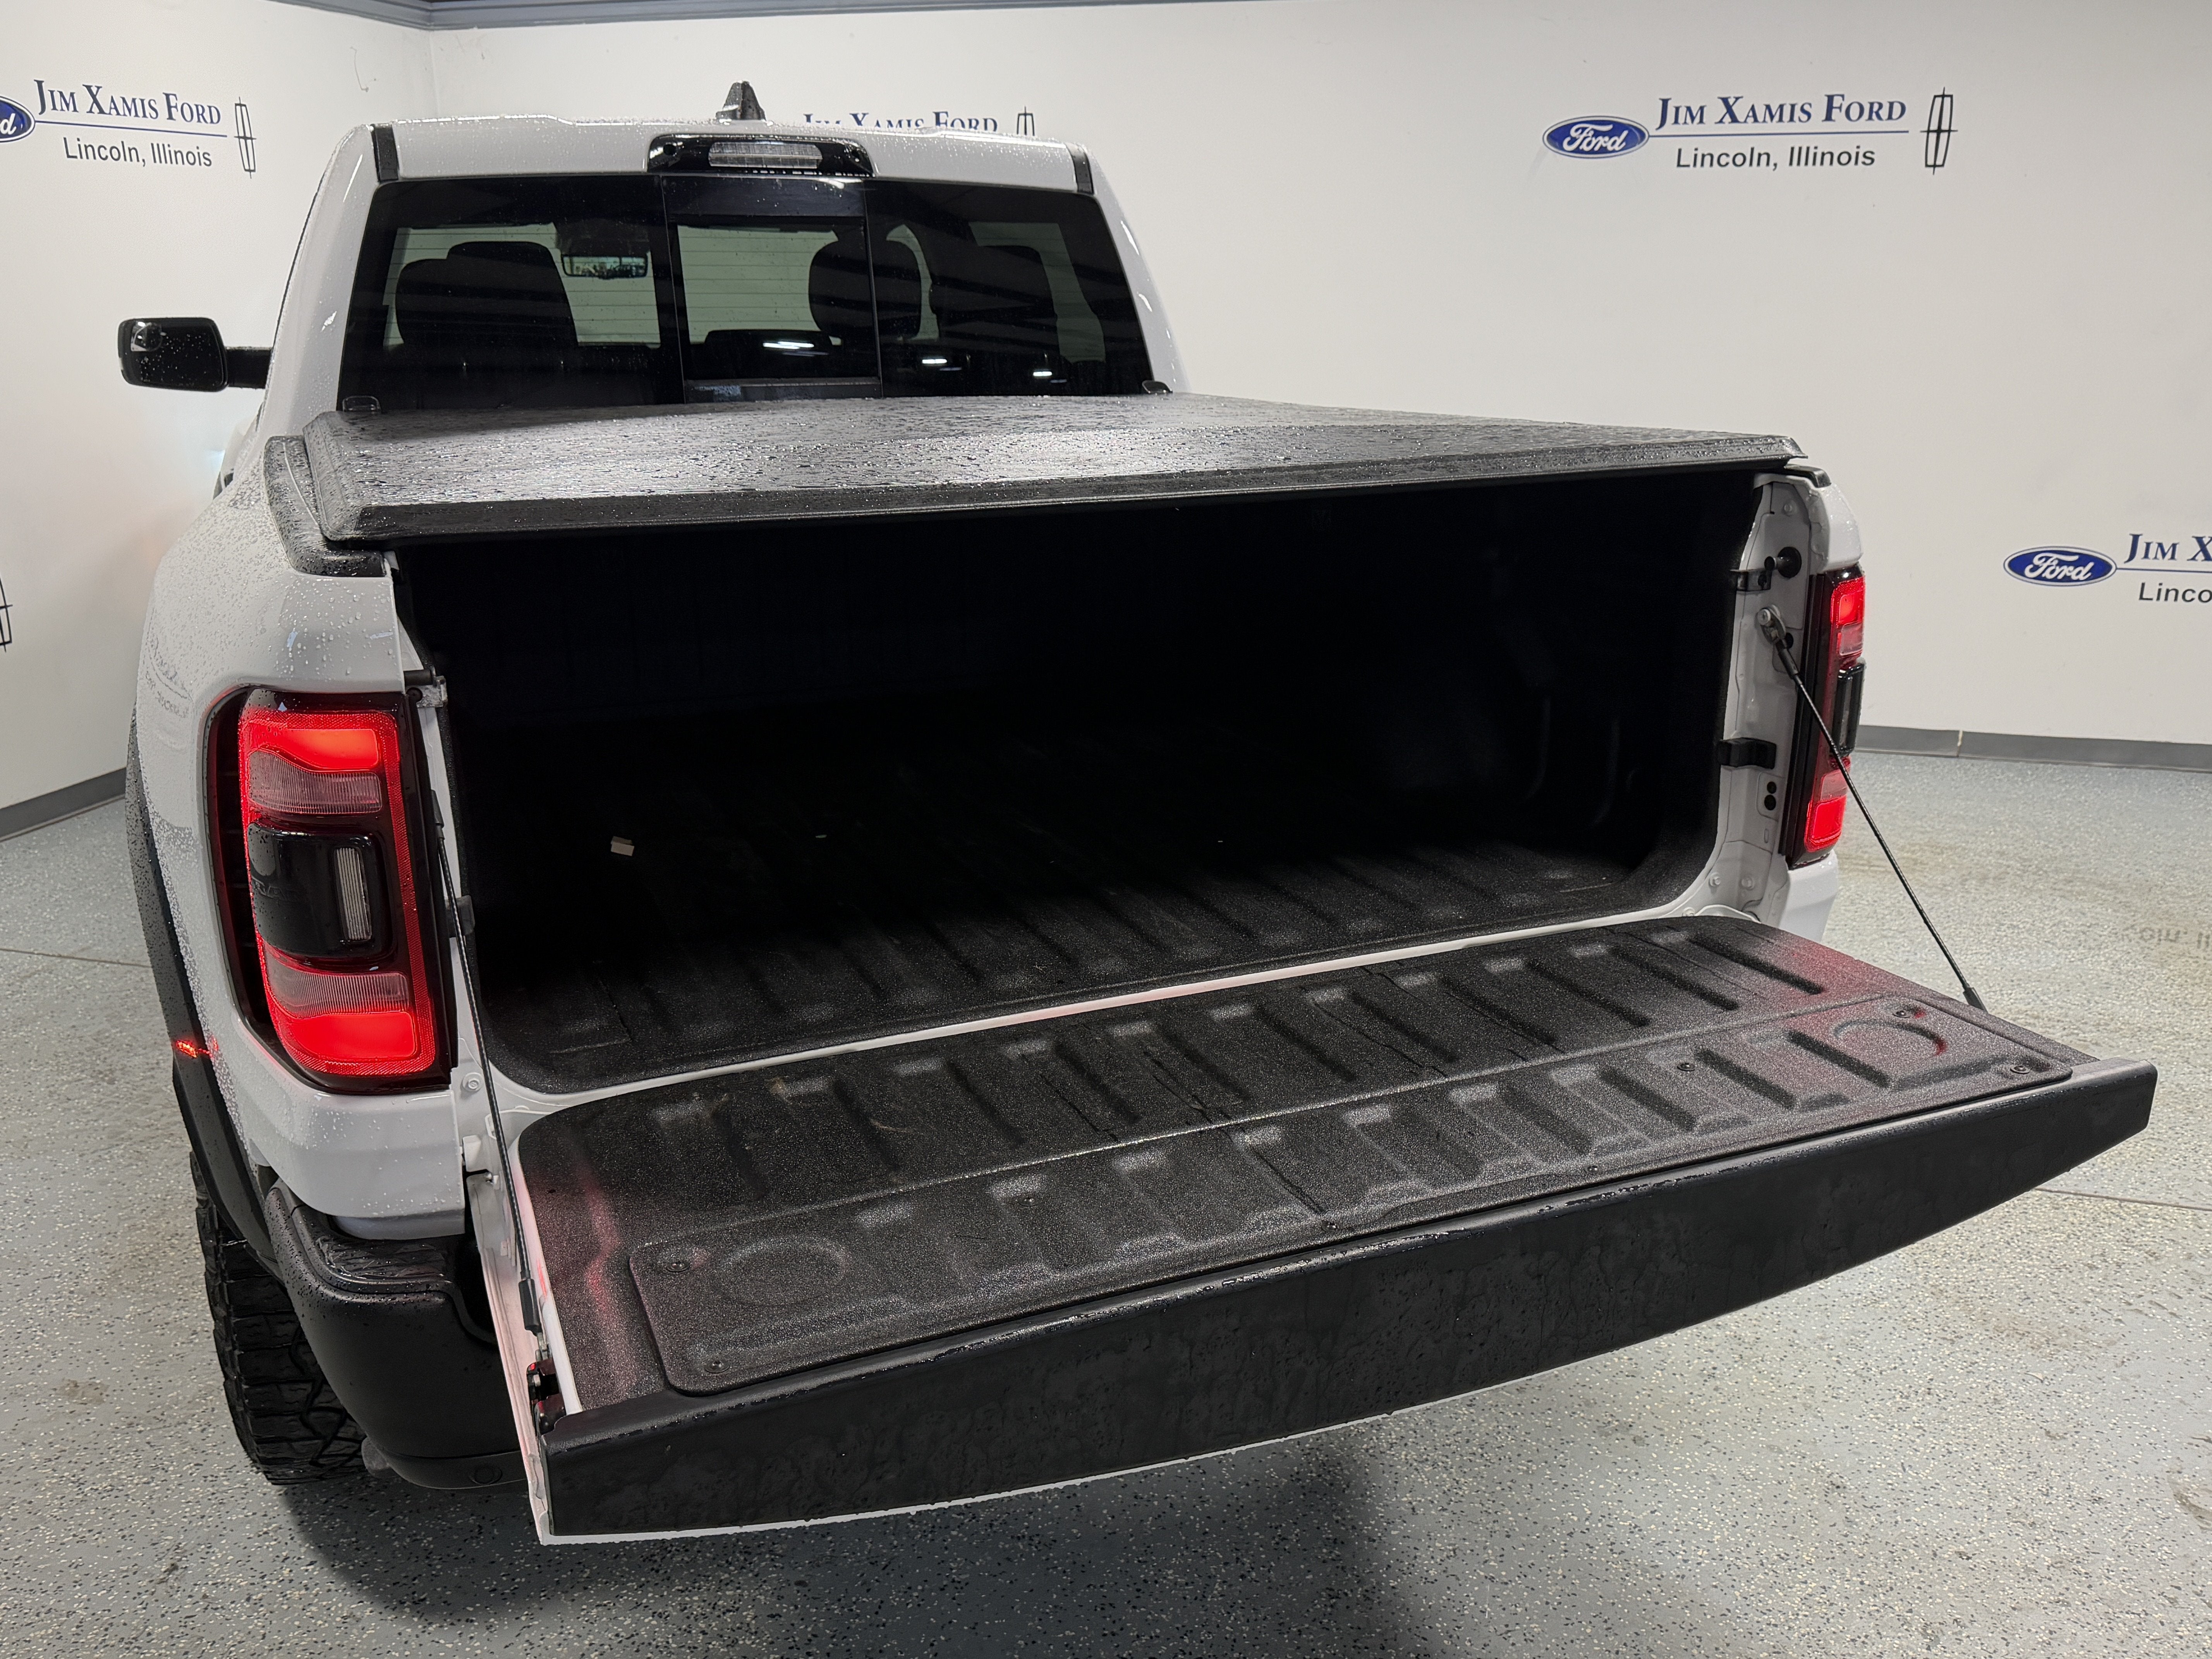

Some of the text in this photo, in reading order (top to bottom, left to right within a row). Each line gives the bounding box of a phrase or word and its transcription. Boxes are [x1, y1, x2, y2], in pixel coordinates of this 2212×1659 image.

[34, 79, 221, 124] JIM XAMIS FORD
[1655, 94, 1906, 131] JIM XAMIS FORD
[1563, 123, 1629, 151] Ford
[63, 137, 212, 167] Lincoln, Illinois
[1676, 145, 1875, 171] Lincoln, Illinois
[2124, 534, 2179, 564] JIM
[2025, 553, 2094, 580] Ford
[2138, 582, 2212, 603] Linco
